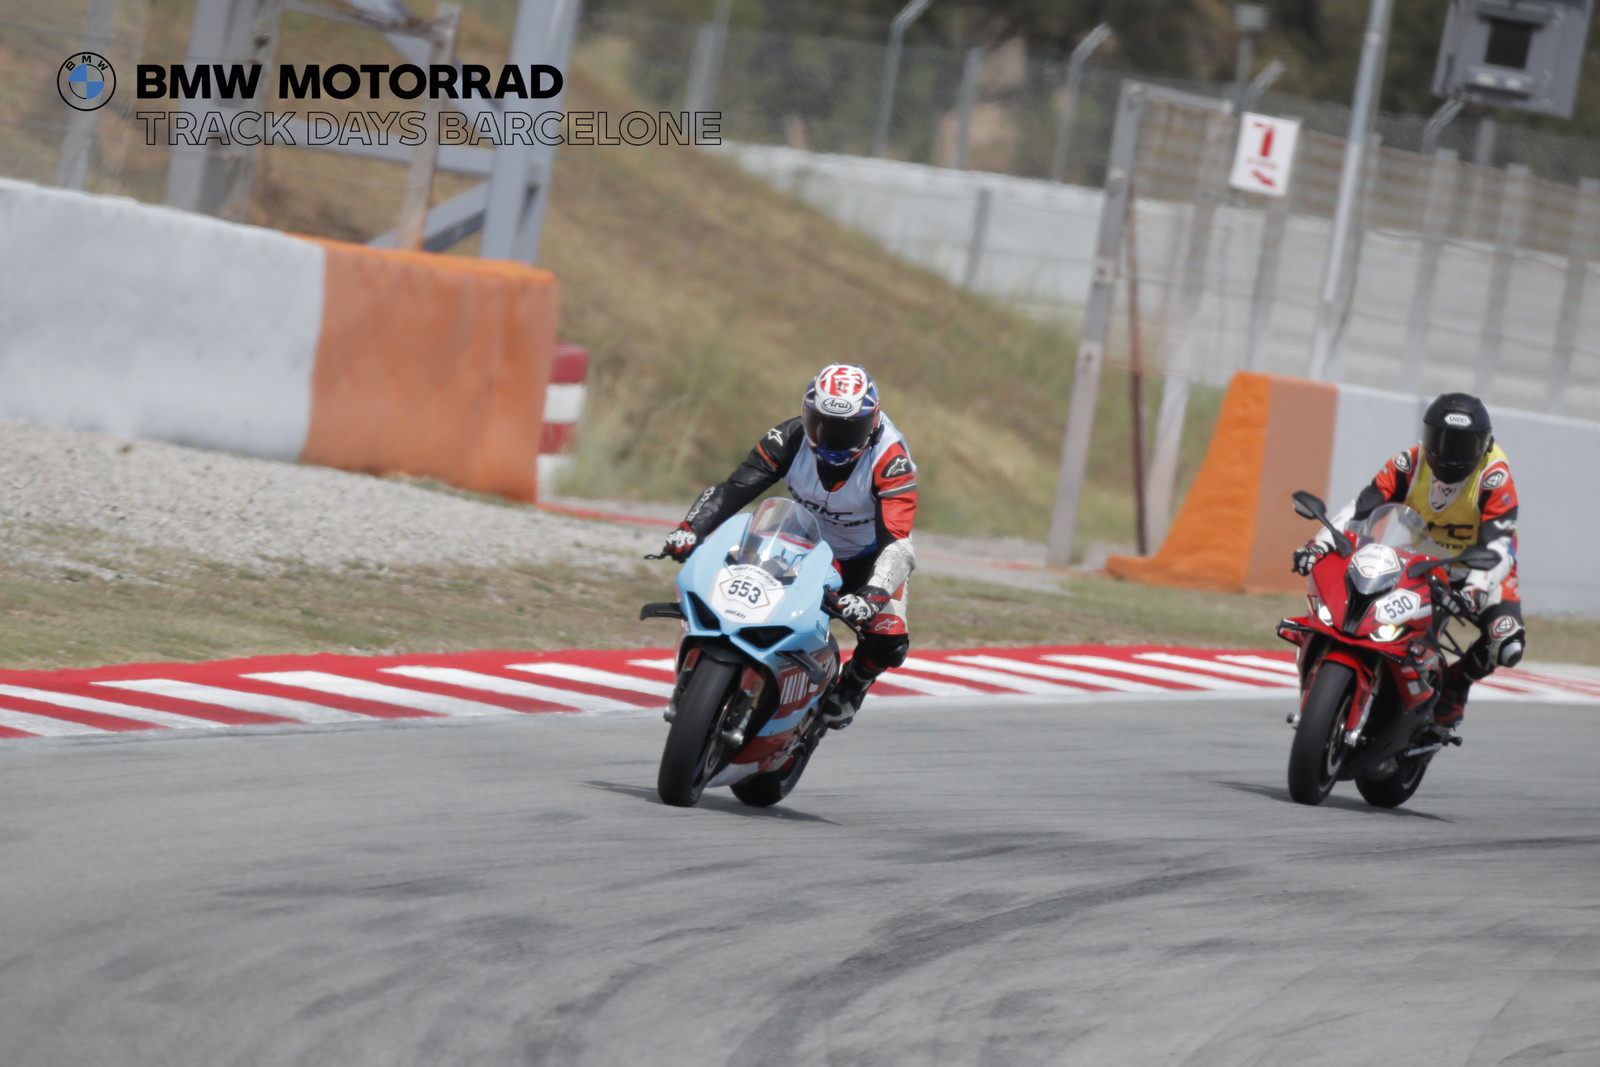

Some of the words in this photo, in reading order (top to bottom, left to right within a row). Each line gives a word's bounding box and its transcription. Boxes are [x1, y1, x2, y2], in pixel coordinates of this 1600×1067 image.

[826, 399, 850, 409] Arai
[727, 579, 762, 604] 553
[1383, 595, 1414, 619] 530
